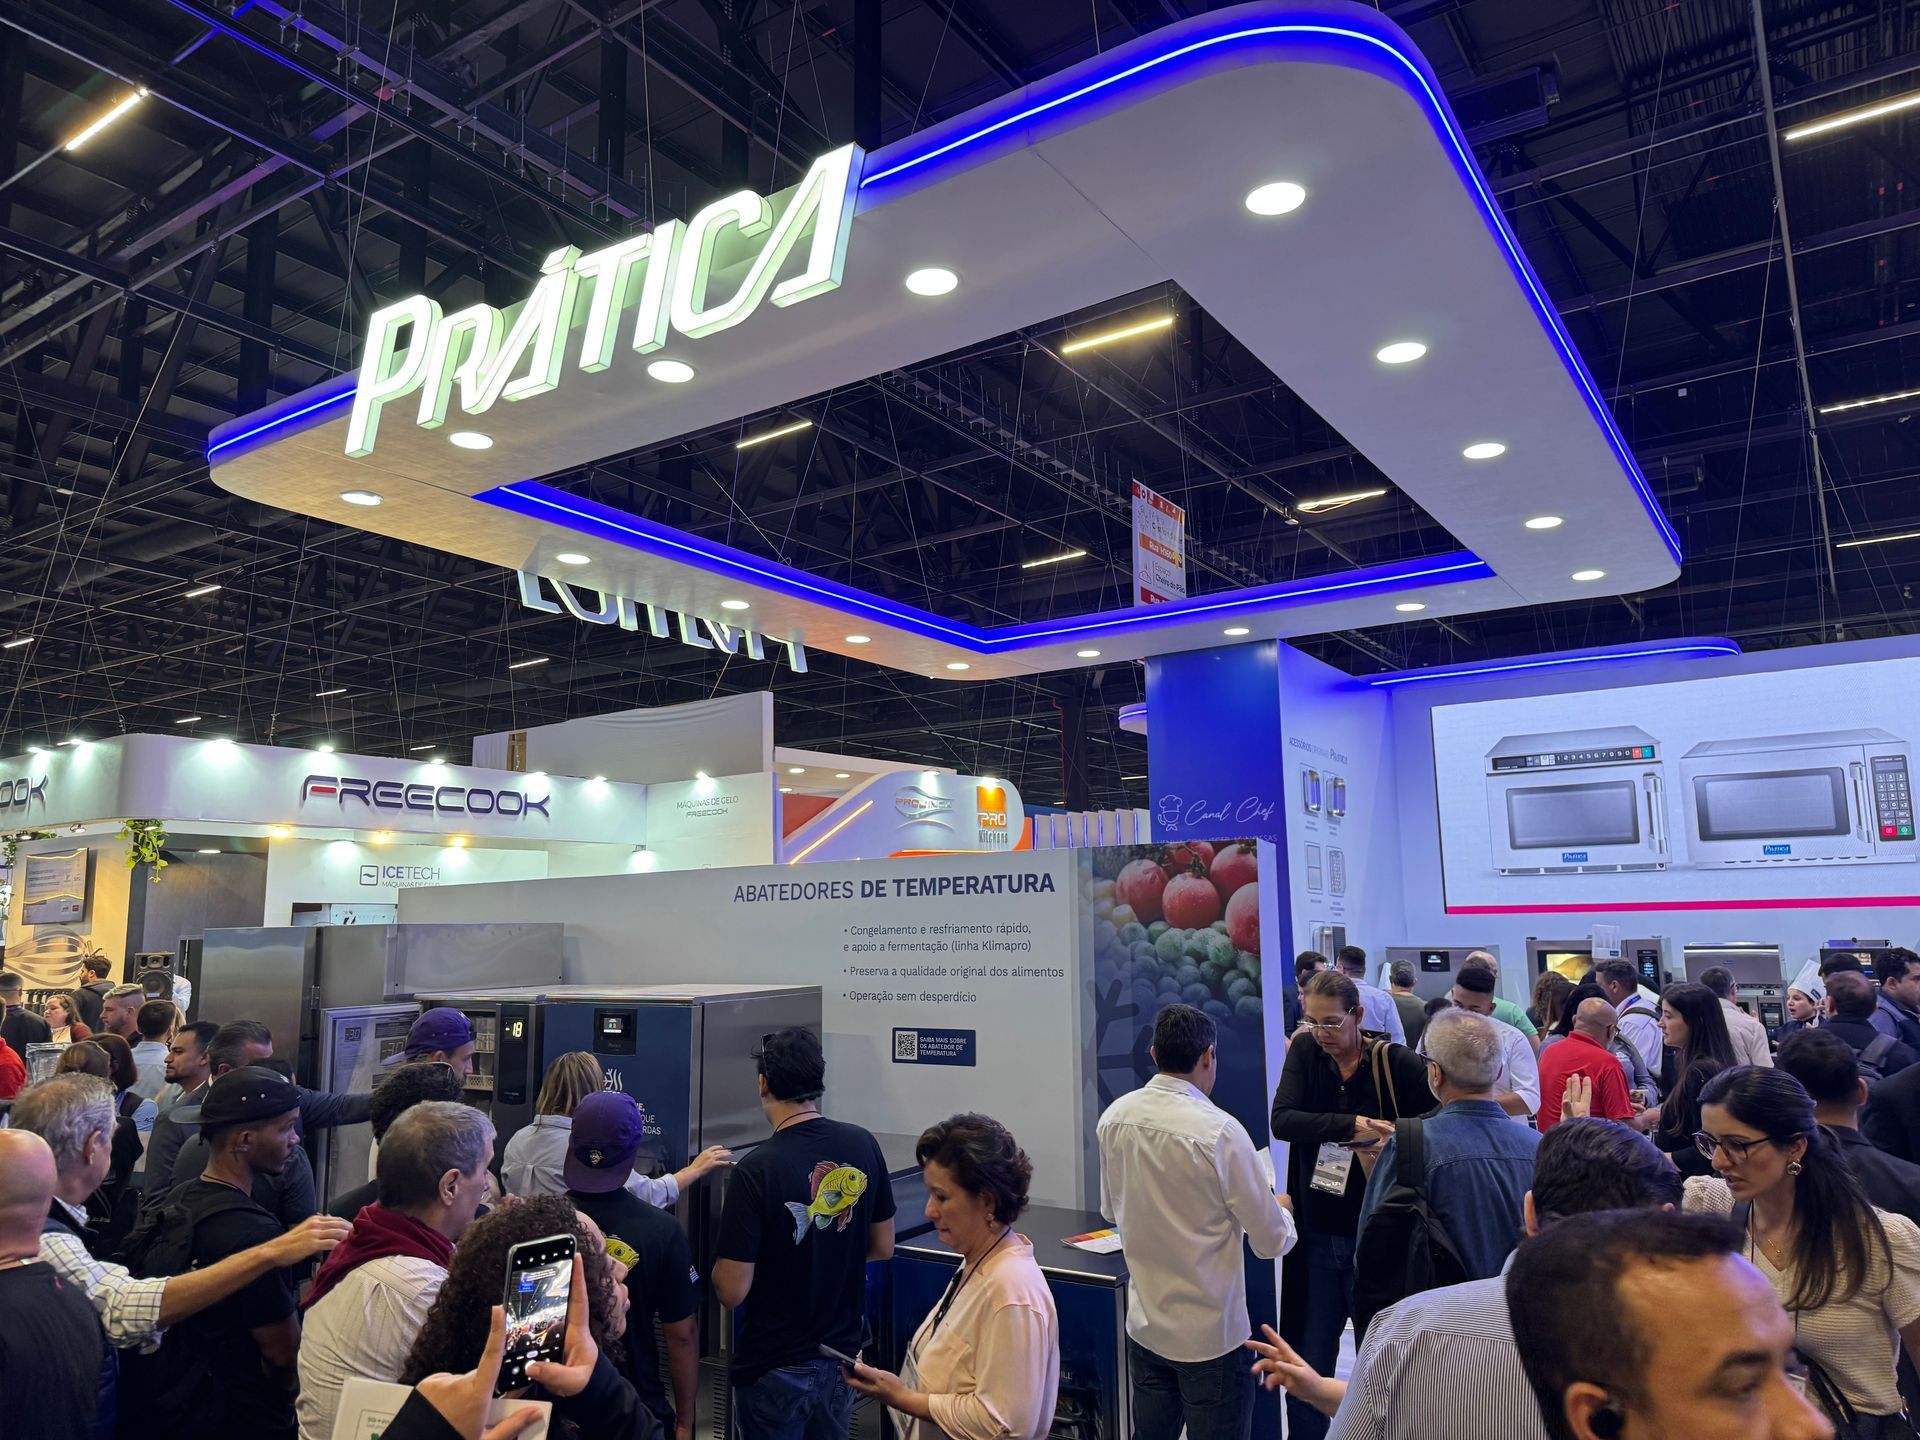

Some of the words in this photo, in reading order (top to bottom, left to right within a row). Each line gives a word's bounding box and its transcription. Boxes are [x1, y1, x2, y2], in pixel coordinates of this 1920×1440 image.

[344, 141, 865, 458] PRÁTICA
[302, 774, 550, 818] FREECOOK
[721, 796, 738, 805] GELO
[1185, 799, 1232, 825] Canal
[1235, 796, 1275, 823] Chef
[978, 812, 1007, 830] PRO
[382, 866, 440, 880] ICETECH
[733, 880, 854, 903] ABATEDORES
[861, 880, 887, 898] DE
[893, 873, 1056, 897] TEMPERATURA
[851, 925, 917, 937] Congelamento
[929, 923, 993, 934] resfriamento
[996, 922, 1032, 936] rápido,
[844, 943, 849, 951] e
[852, 942, 876, 953] apoio
[888, 940, 948, 953] fermentação
[951, 940, 979, 953] (linha
[982, 940, 1031, 953] Klimapro)
[850, 966, 890, 976] Preserva
[900, 966, 947, 978] qualidade
[950, 965, 987, 979] original
[989, 966, 1008, 977] dos
[1011, 966, 1064, 977] alimentos
[850, 991, 893, 1004] Operação
[896, 993, 917, 1001] sem
[919, 990, 977, 1004] desperdício
[505, 1022, 523, 1038] -18
